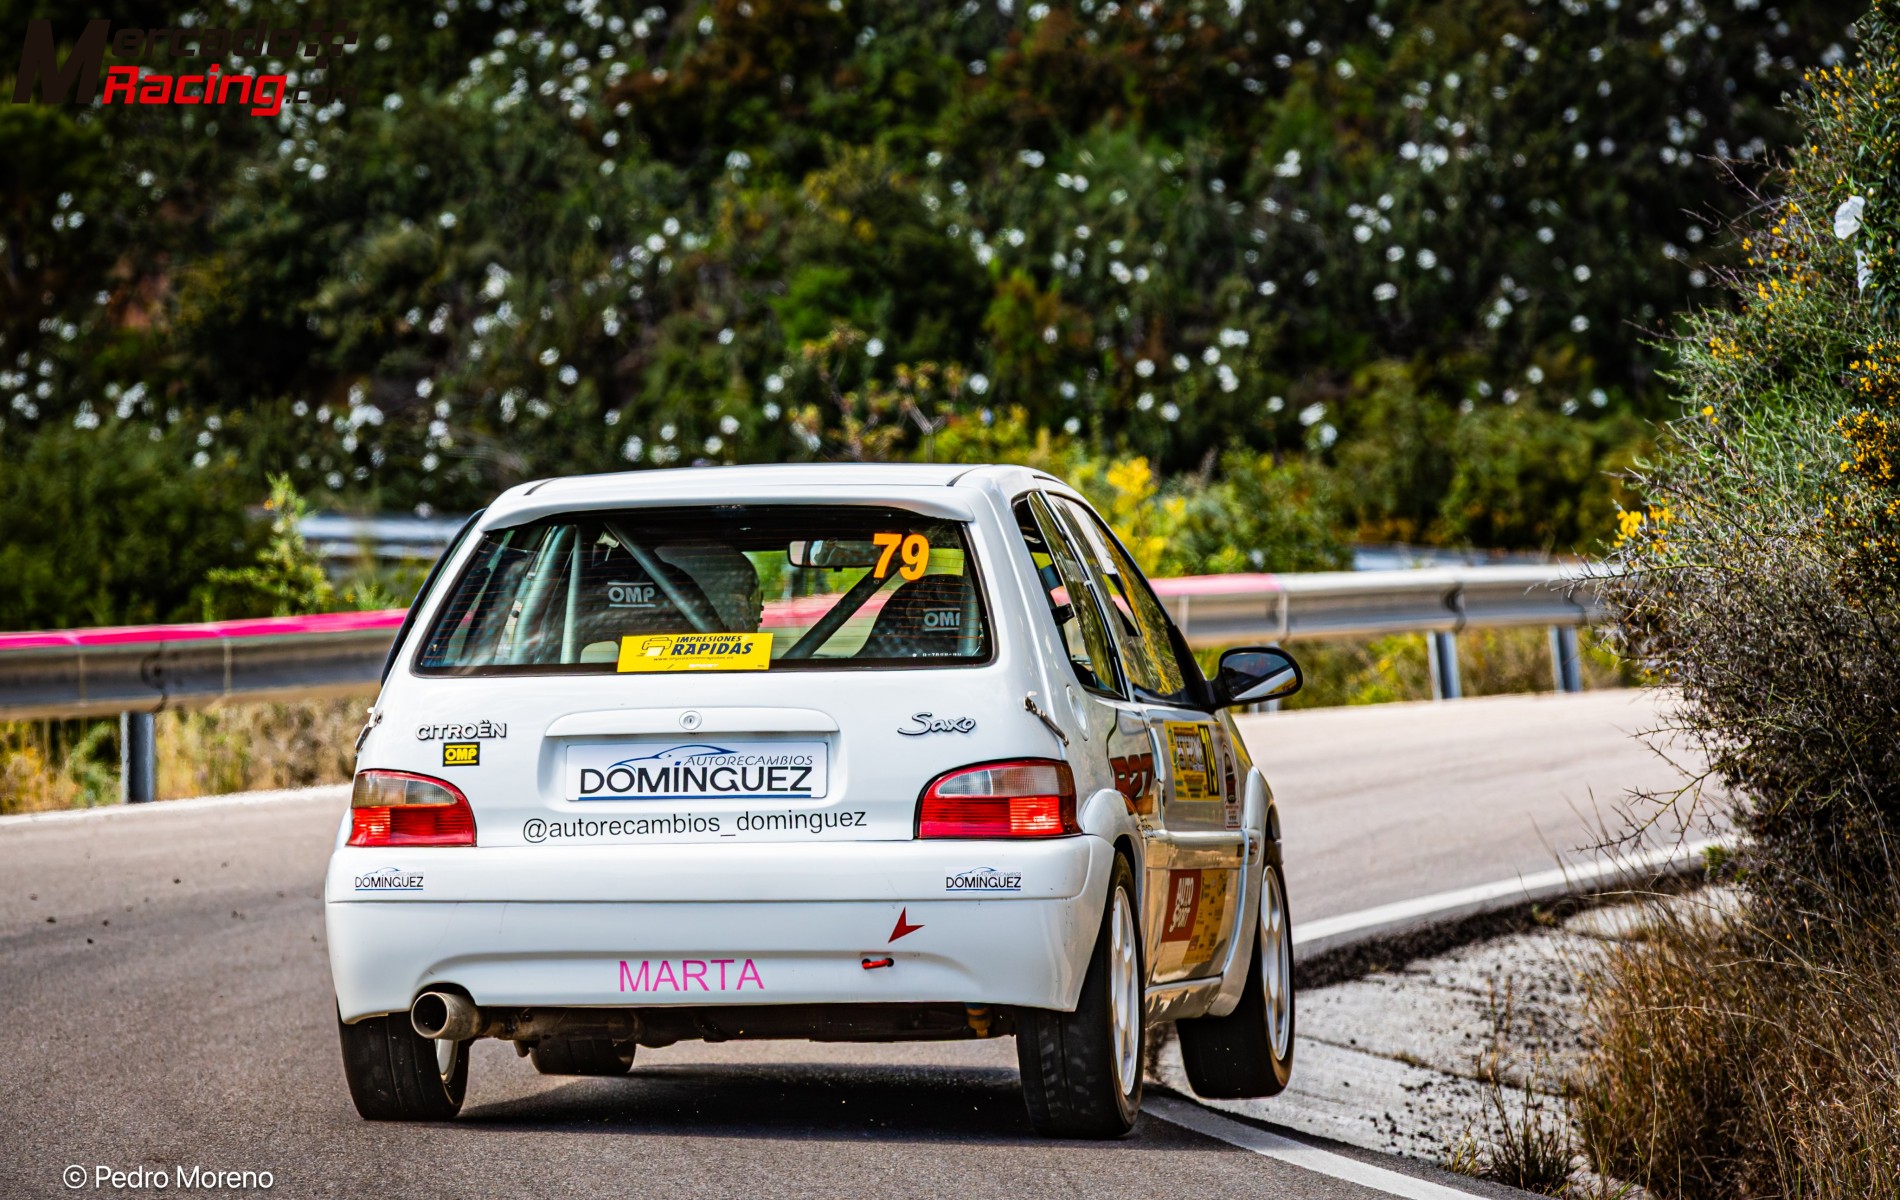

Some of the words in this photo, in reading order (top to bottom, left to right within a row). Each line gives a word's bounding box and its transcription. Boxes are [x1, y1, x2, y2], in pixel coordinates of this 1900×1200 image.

[873, 532, 930, 581] 79
[608, 586, 655, 602] OMP
[676, 635, 742, 643] IMPRESIONES
[415, 719, 507, 741] CITROËN
[897, 711, 976, 736] Saxo
[445, 748, 478, 761] OMP
[684, 755, 813, 767] AUTORECAMBIOS
[522, 810, 867, 843] @autorecambios_dominguez
[618, 958, 765, 992] MARTA
